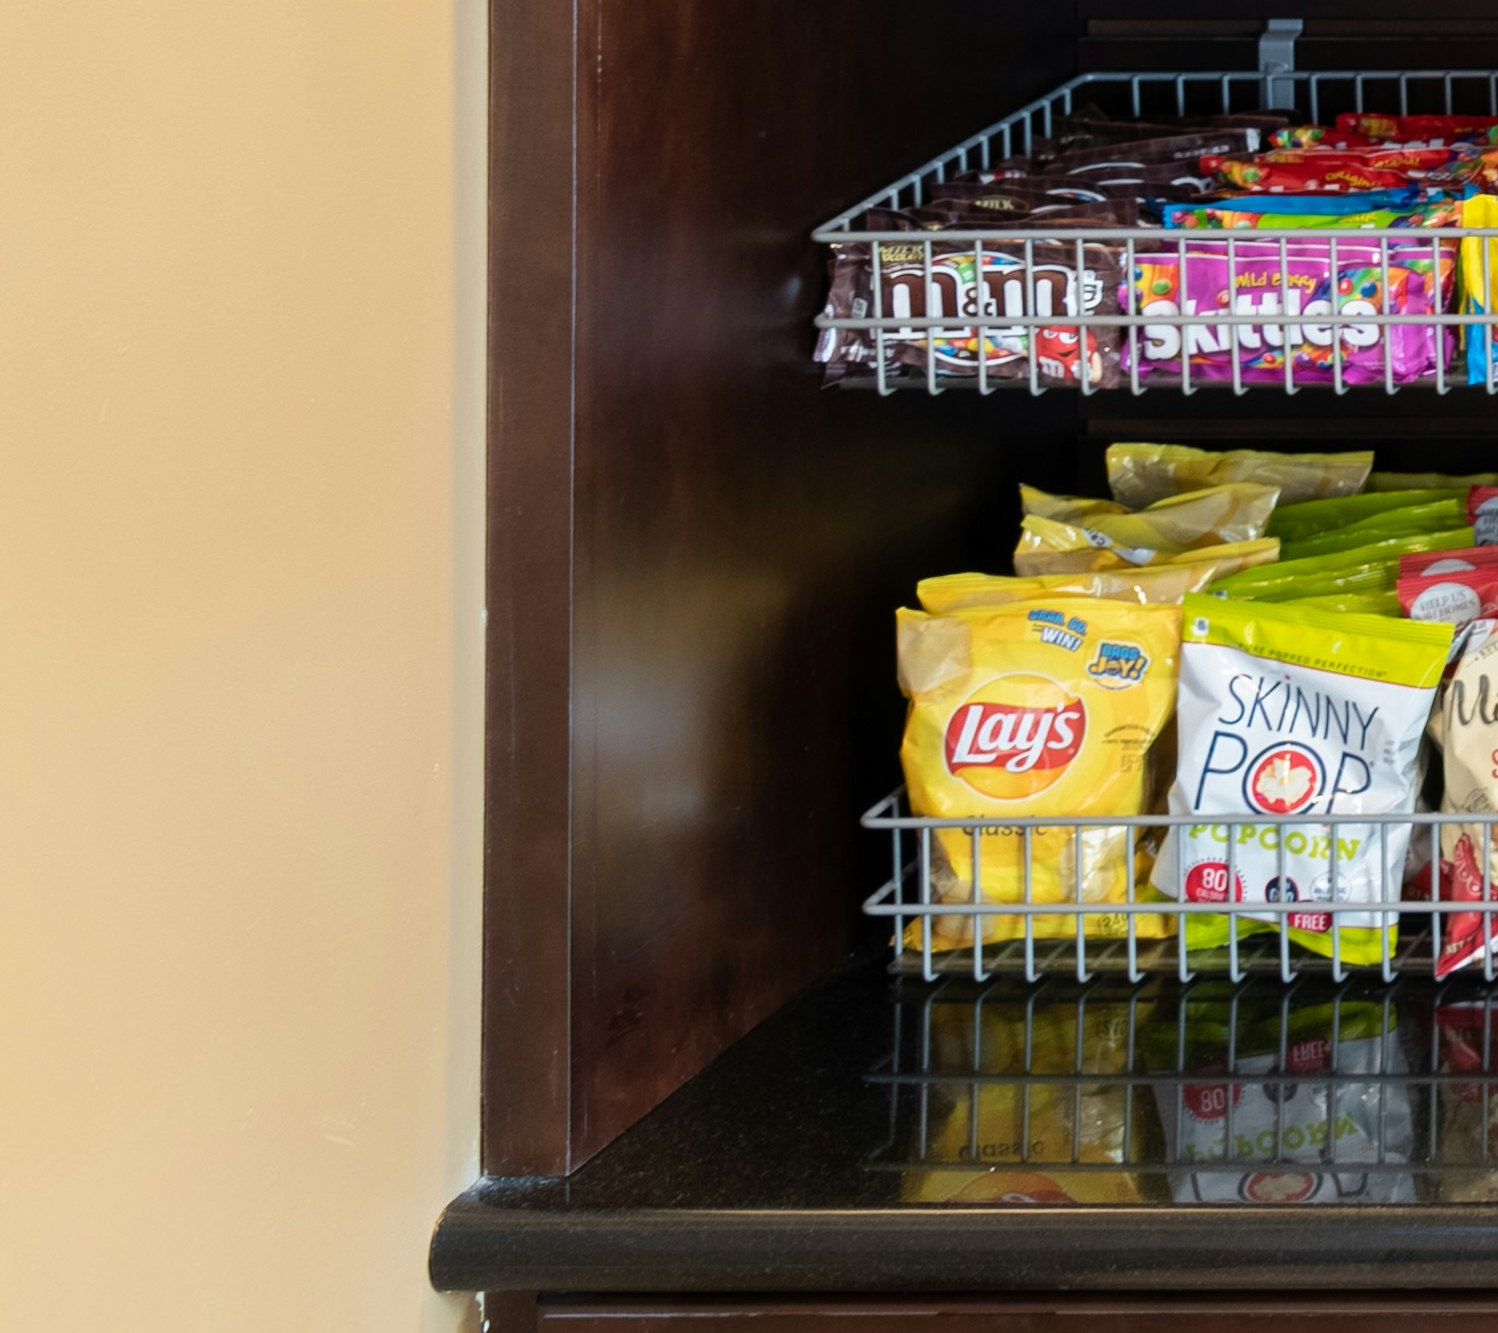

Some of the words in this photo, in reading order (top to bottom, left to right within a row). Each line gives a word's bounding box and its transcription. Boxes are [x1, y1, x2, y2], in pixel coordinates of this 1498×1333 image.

[1040, 626, 1081, 652] WIN!
[1218, 674, 1381, 752] SKINNY
[950, 702, 1083, 772] Lay's
[1202, 867, 1227, 892] 80
[1294, 914, 1327, 930] FREE
